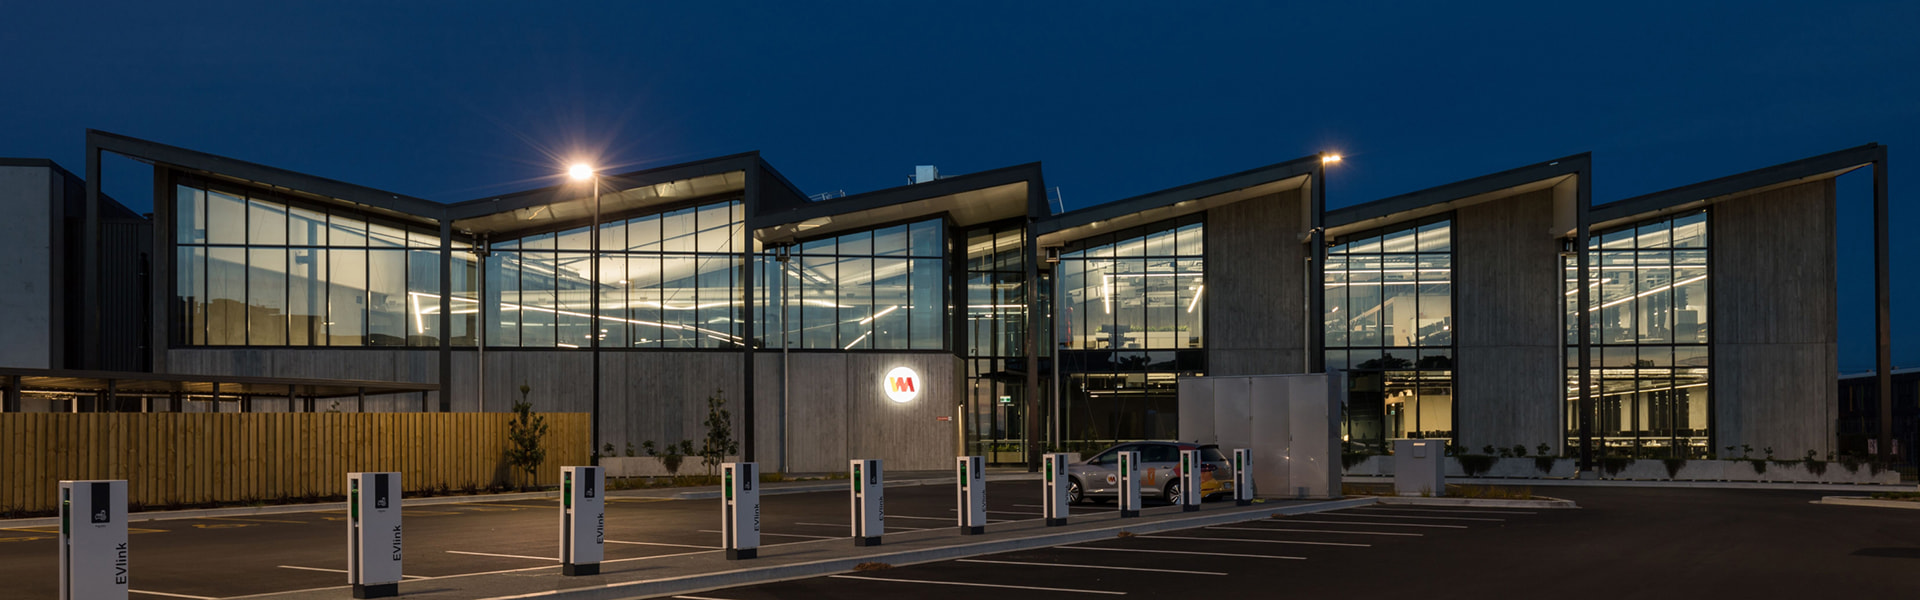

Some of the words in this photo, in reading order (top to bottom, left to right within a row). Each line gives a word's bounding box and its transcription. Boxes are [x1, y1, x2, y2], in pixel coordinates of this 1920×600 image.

[392, 524, 402, 562] EVlink
[596, 512, 604, 545] EVlink
[115, 542, 127, 585] EVlink
